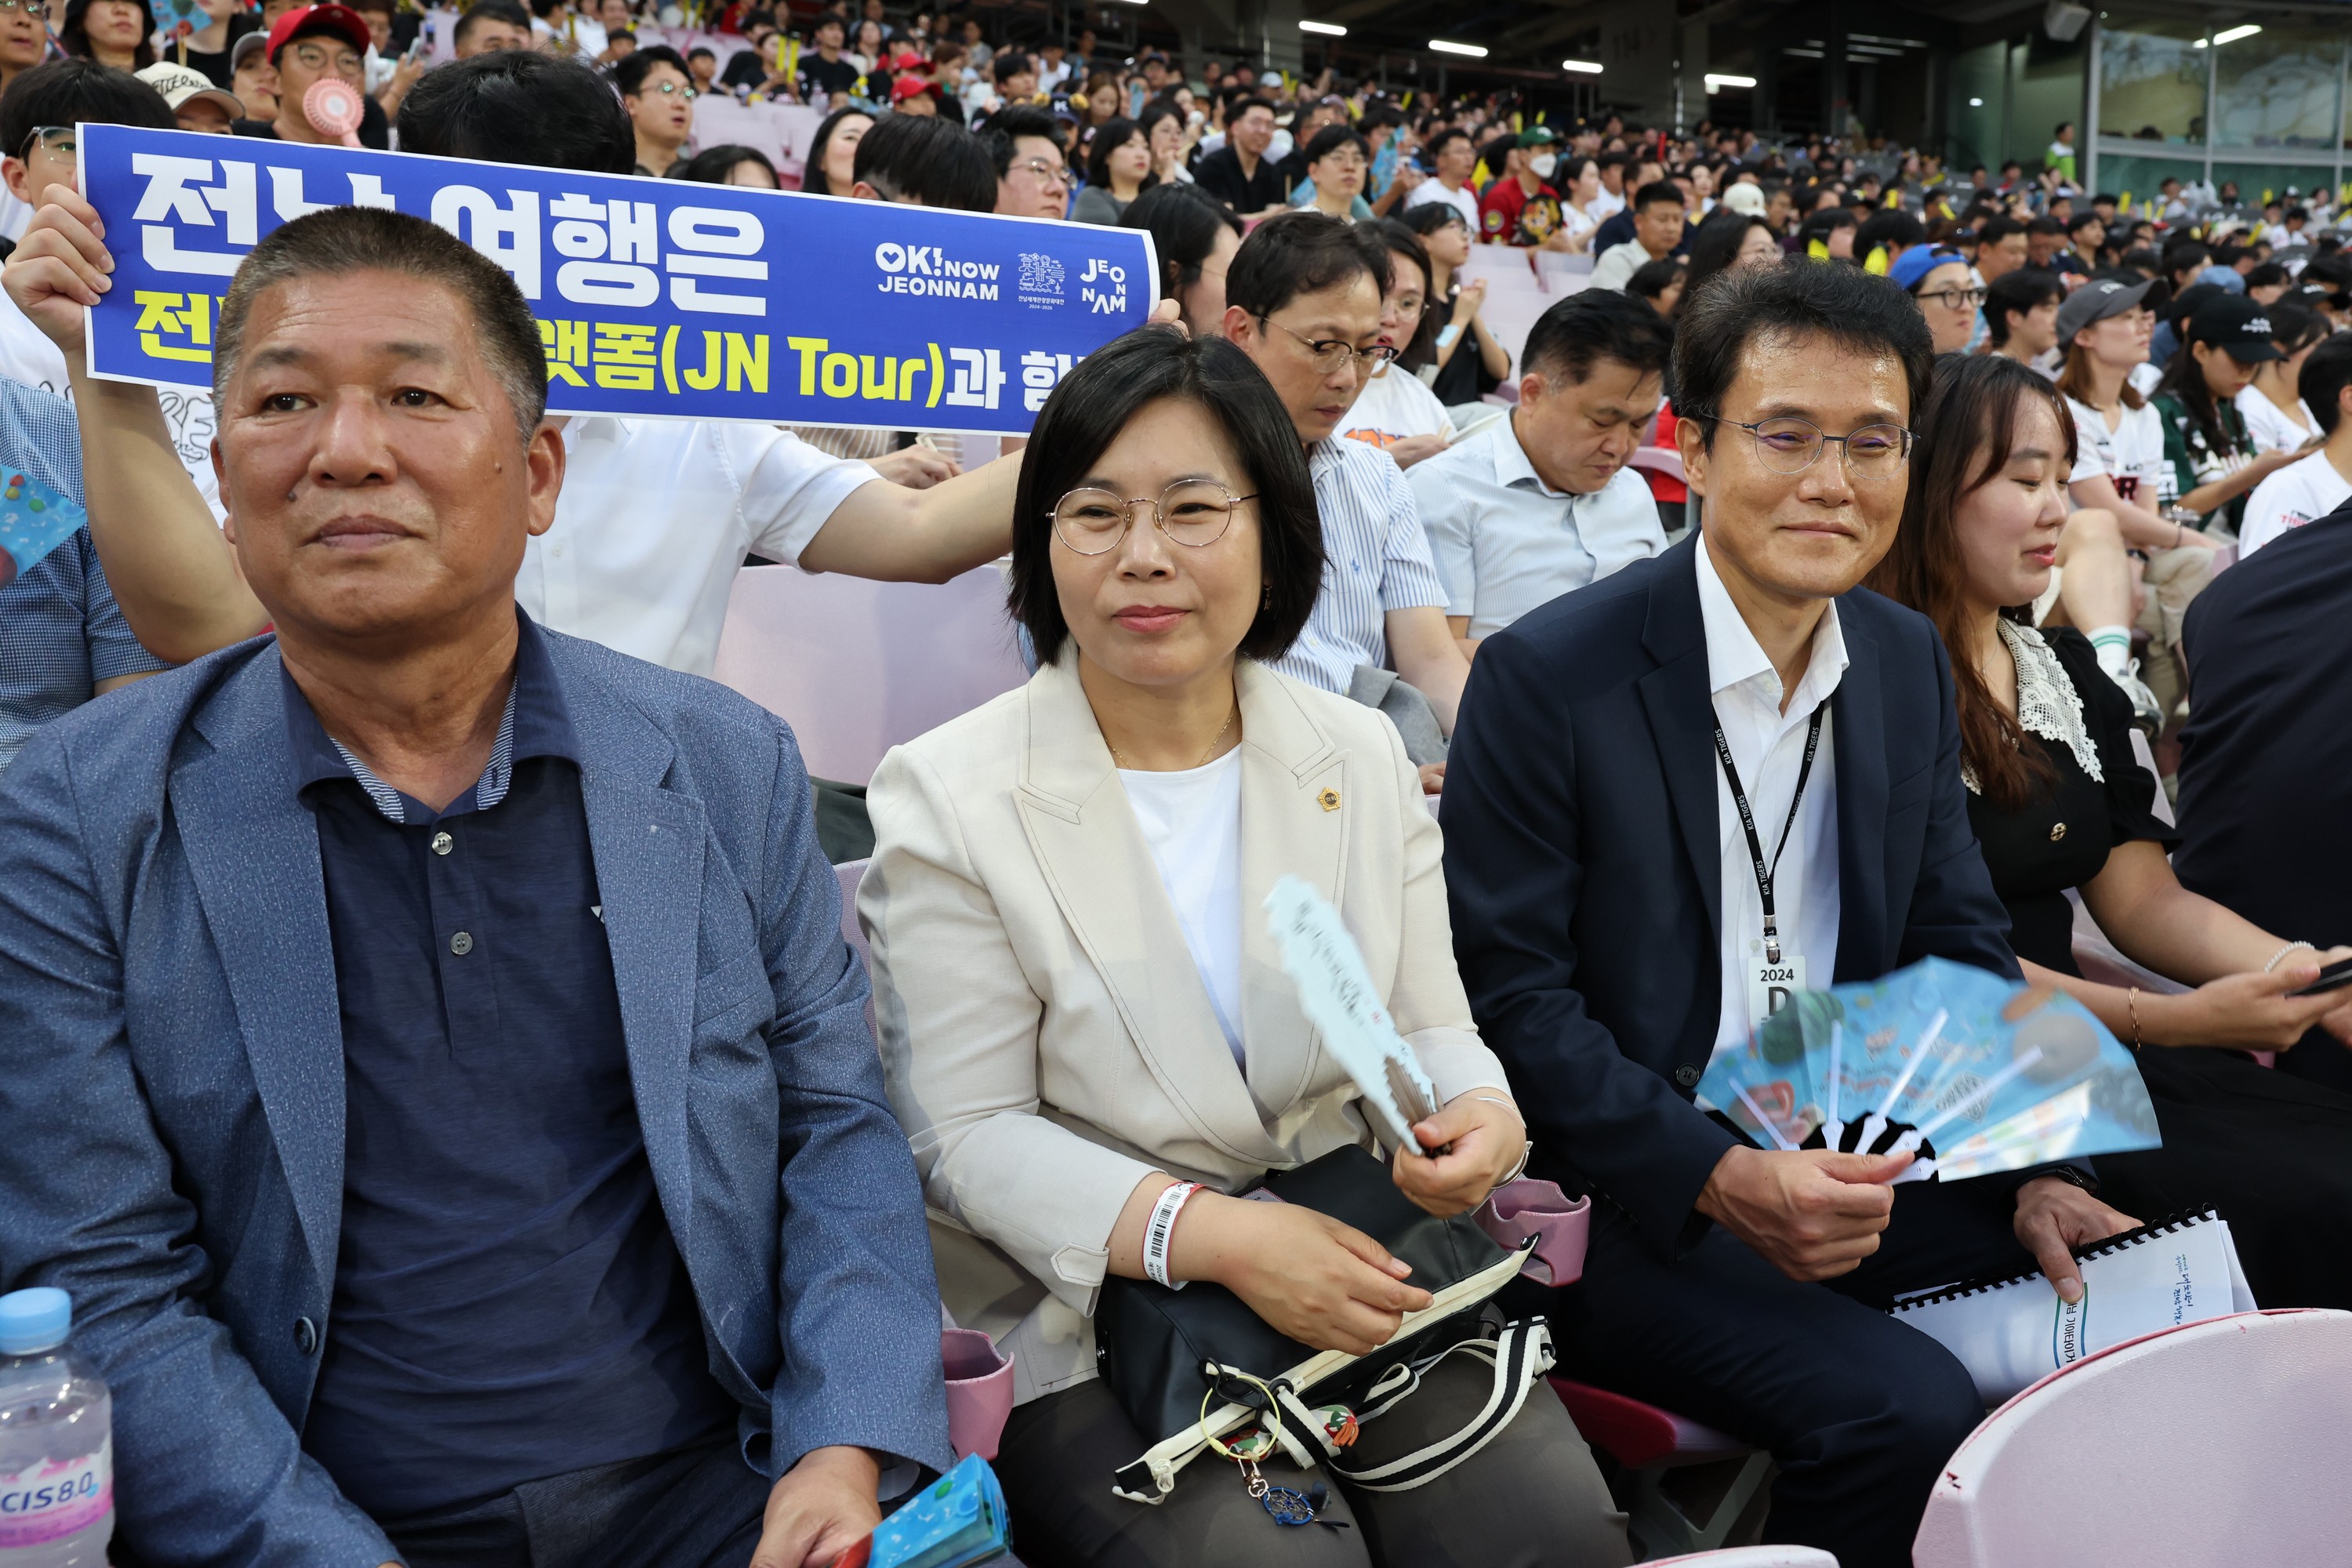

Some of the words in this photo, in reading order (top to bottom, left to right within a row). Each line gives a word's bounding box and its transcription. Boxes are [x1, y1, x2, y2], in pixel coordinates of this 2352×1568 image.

[430, 184, 767, 317] 여행은
[875, 242, 943, 278] OK!
[944, 260, 1000, 281] NOW
[877, 275, 1000, 302] JEONNAM
[134, 290, 227, 363] 전
[536, 319, 769, 396] 랫폼(JN
[787, 336, 1007, 410] Tour)과
[1021, 350, 1086, 412] 함
[1715, 728, 1727, 753] TIGERS
[1809, 727, 1820, 750] TIGERS
[1723, 753, 1732, 765] KIA
[1806, 750, 1815, 762] KIA
[1737, 794, 1750, 818] TIGERS
[1745, 818, 1755, 831] KIA
[1756, 860, 1767, 884] TIGERS
[1762, 883, 1770, 895] KIA
[1760, 968, 1795, 982] 2024
[1768, 986, 1793, 1016] D
[2173, 1289, 2182, 1305] 전남
[2063, 1317, 2076, 1363] 기아타이거
